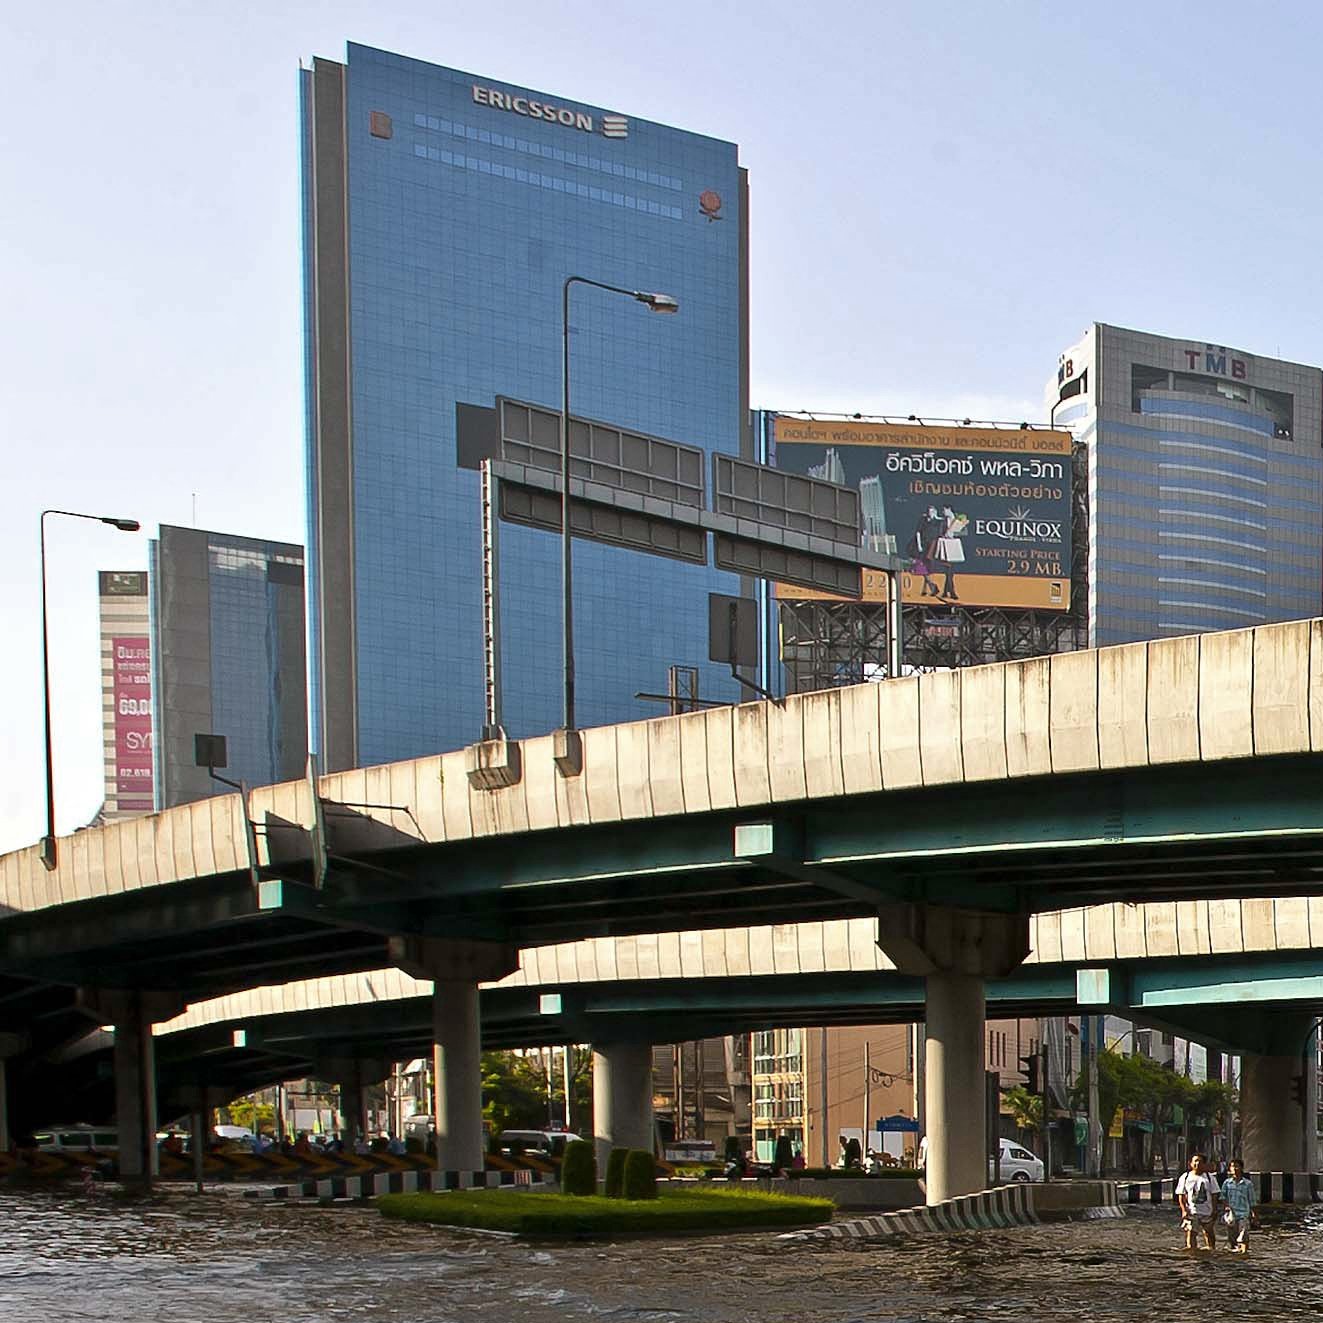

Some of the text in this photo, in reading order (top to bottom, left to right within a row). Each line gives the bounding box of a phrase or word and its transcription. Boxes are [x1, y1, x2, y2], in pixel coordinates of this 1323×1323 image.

[472, 84, 593, 132] ERICSSON
[1184, 349, 1246, 379] TMB
[975, 520, 1062, 539] EQUINOX
[1007, 560, 1065, 576] 2.9 MB.
